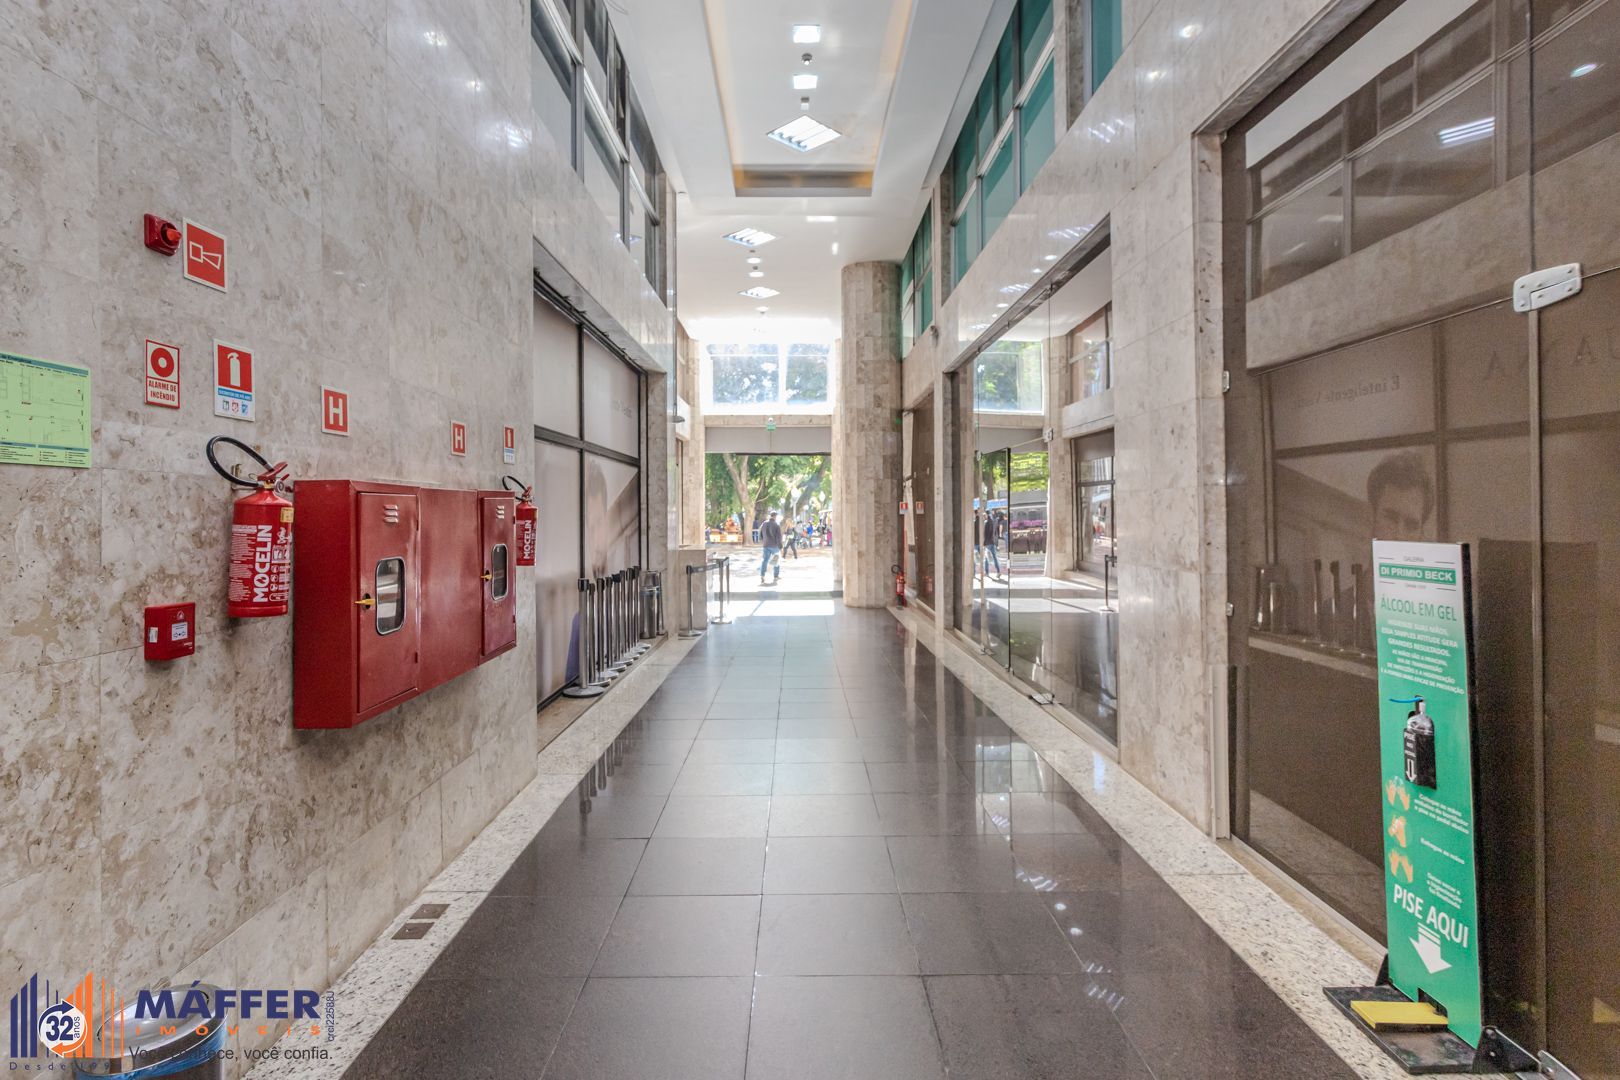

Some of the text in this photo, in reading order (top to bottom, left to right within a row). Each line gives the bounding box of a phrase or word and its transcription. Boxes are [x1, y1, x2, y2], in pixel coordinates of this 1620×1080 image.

[149, 380, 170, 391] ALARME
[150, 390, 175, 402] INCÊNDIO
[329, 396, 343, 426] H
[454, 427, 463, 450] H
[524, 520, 532, 559] MOCELIN
[253, 525, 272, 602] MOCELIN
[1381, 567, 1453, 581] DI PRIMIO BECK
[1381, 594, 1457, 621] ÁLCOOL EM GEL
[1394, 884, 1469, 948] PISE AQUI
